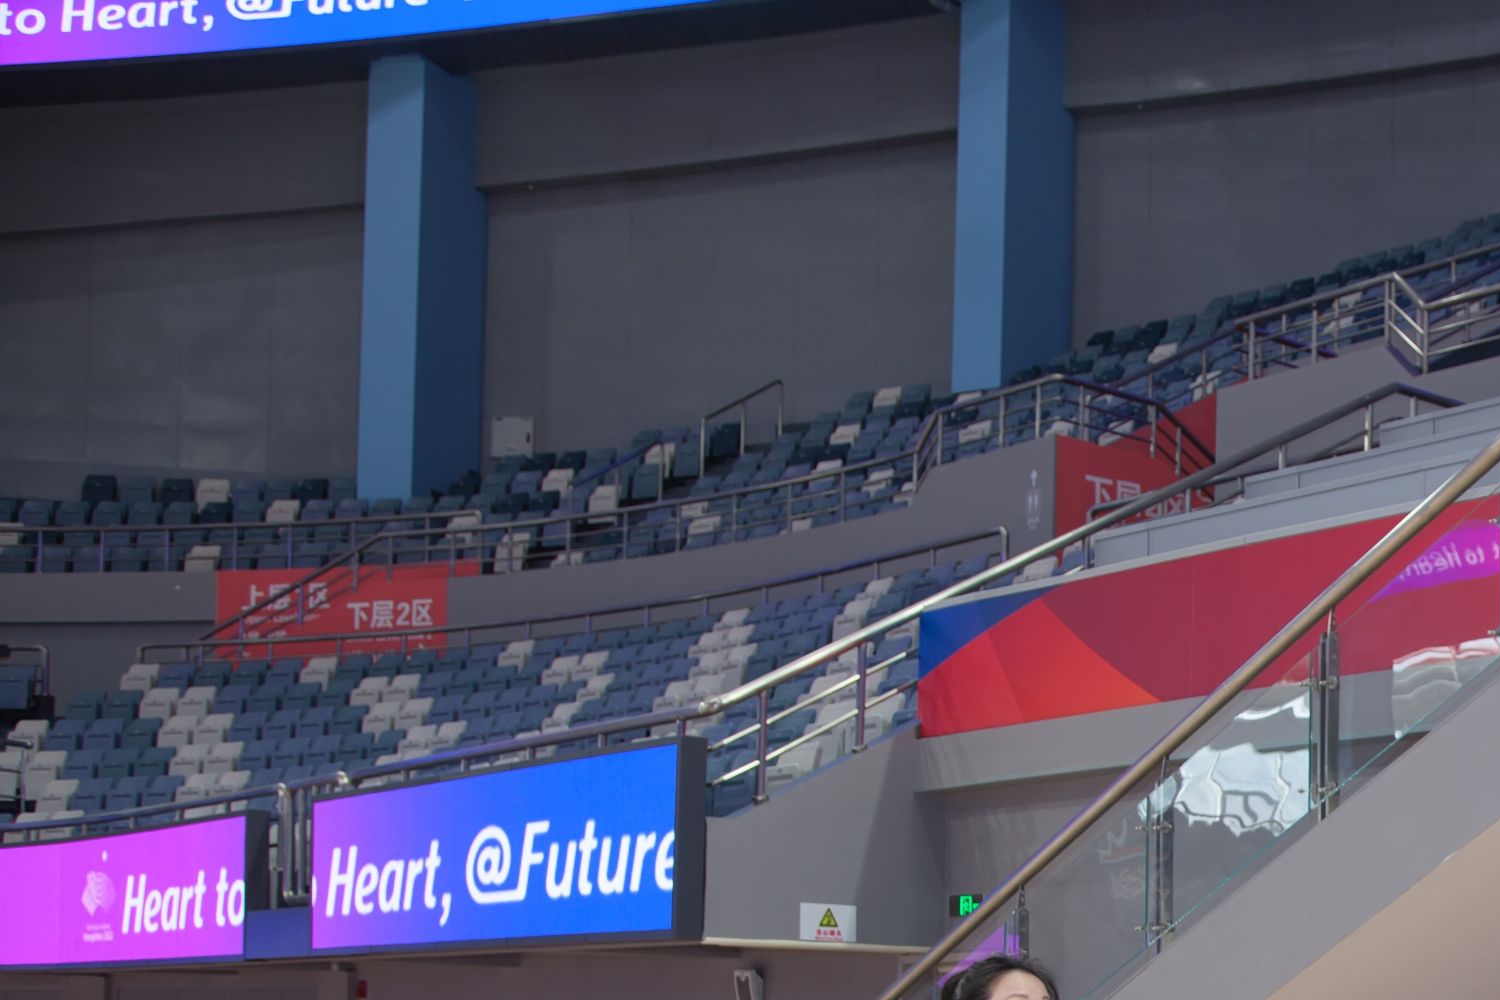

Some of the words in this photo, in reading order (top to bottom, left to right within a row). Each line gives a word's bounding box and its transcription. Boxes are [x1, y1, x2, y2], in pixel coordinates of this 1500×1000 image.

[0, 2, 46, 36] to
[61, 0, 214, 33] Heart,
[241, 582, 331, 611] 上层区
[347, 598, 434, 630] 下层2区
[325, 839, 452, 927] Heart,
[465, 819, 675, 905] @Future
[121, 867, 207, 935] Heart
[215, 866, 246, 928] to
